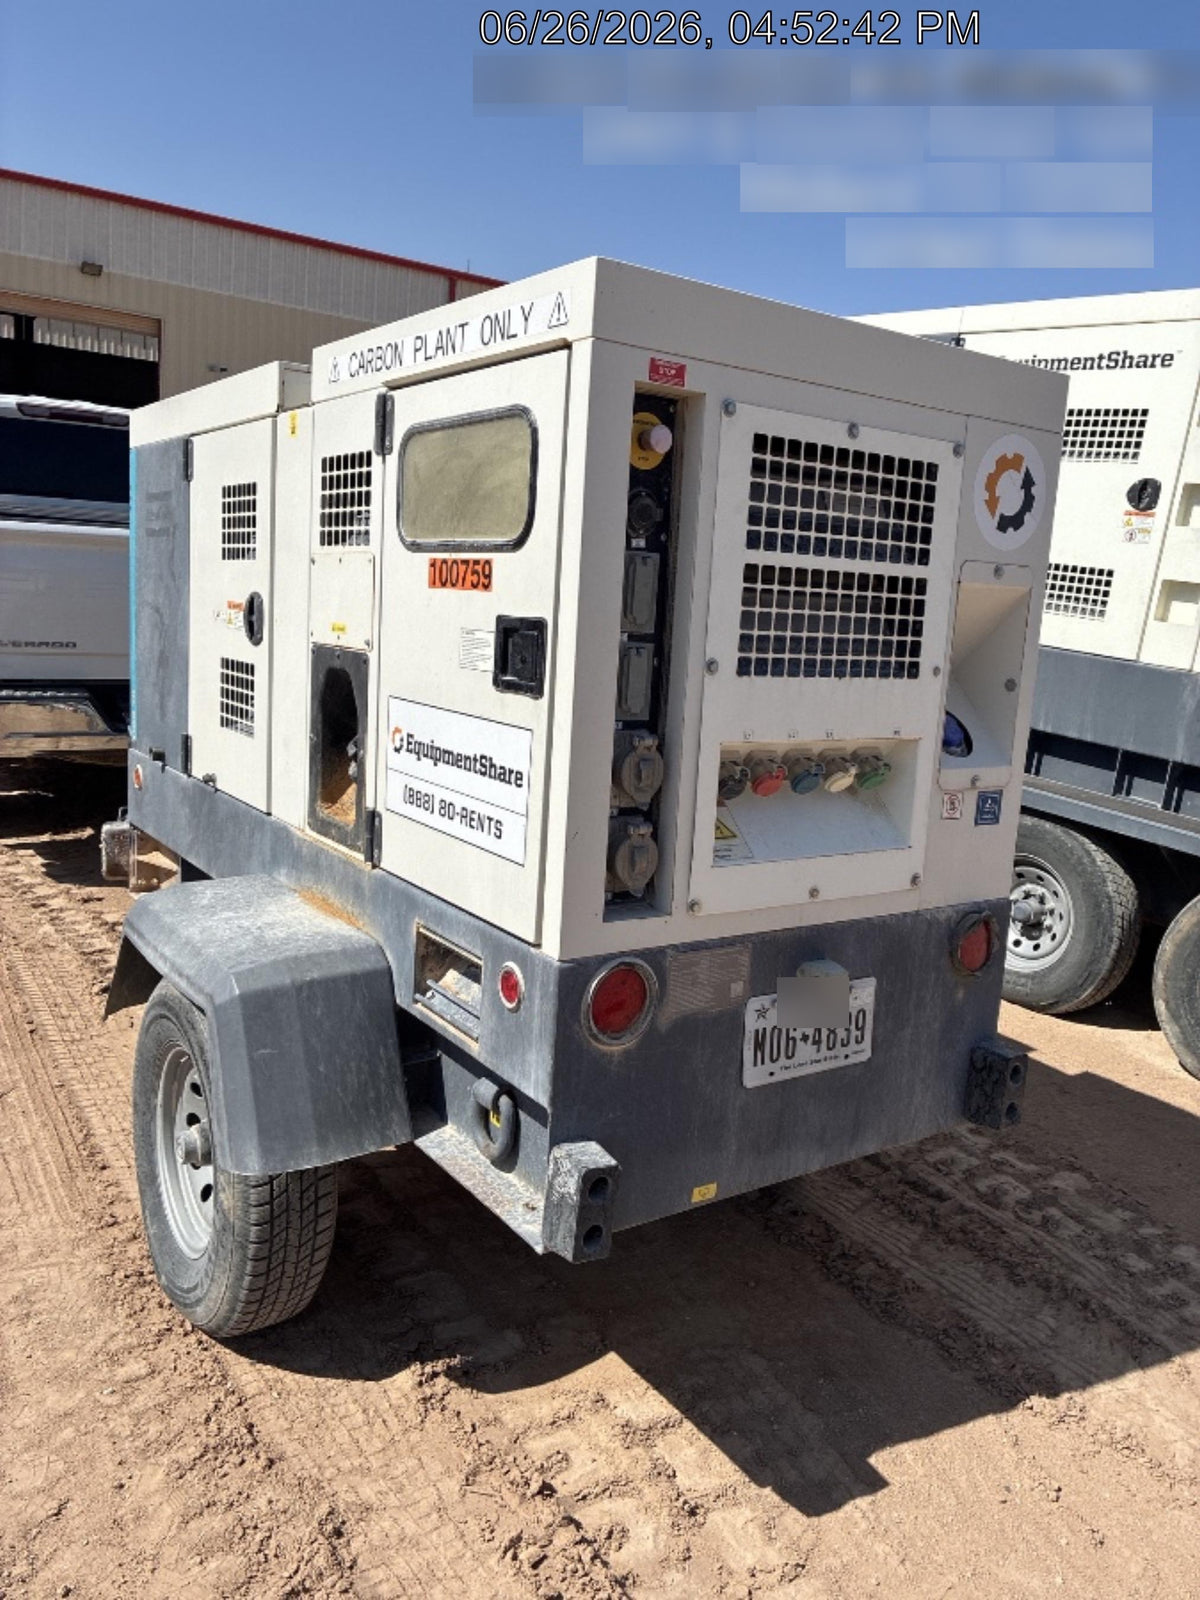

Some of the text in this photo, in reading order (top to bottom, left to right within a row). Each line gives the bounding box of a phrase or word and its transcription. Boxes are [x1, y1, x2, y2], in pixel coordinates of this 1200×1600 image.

[348, 302, 534, 378] CARBON PLANT ONLY
[429, 558, 492, 590] 100759
[405, 733, 524, 789] EquipmentShare
[403, 784, 503, 840] (888) 80-RENTS
